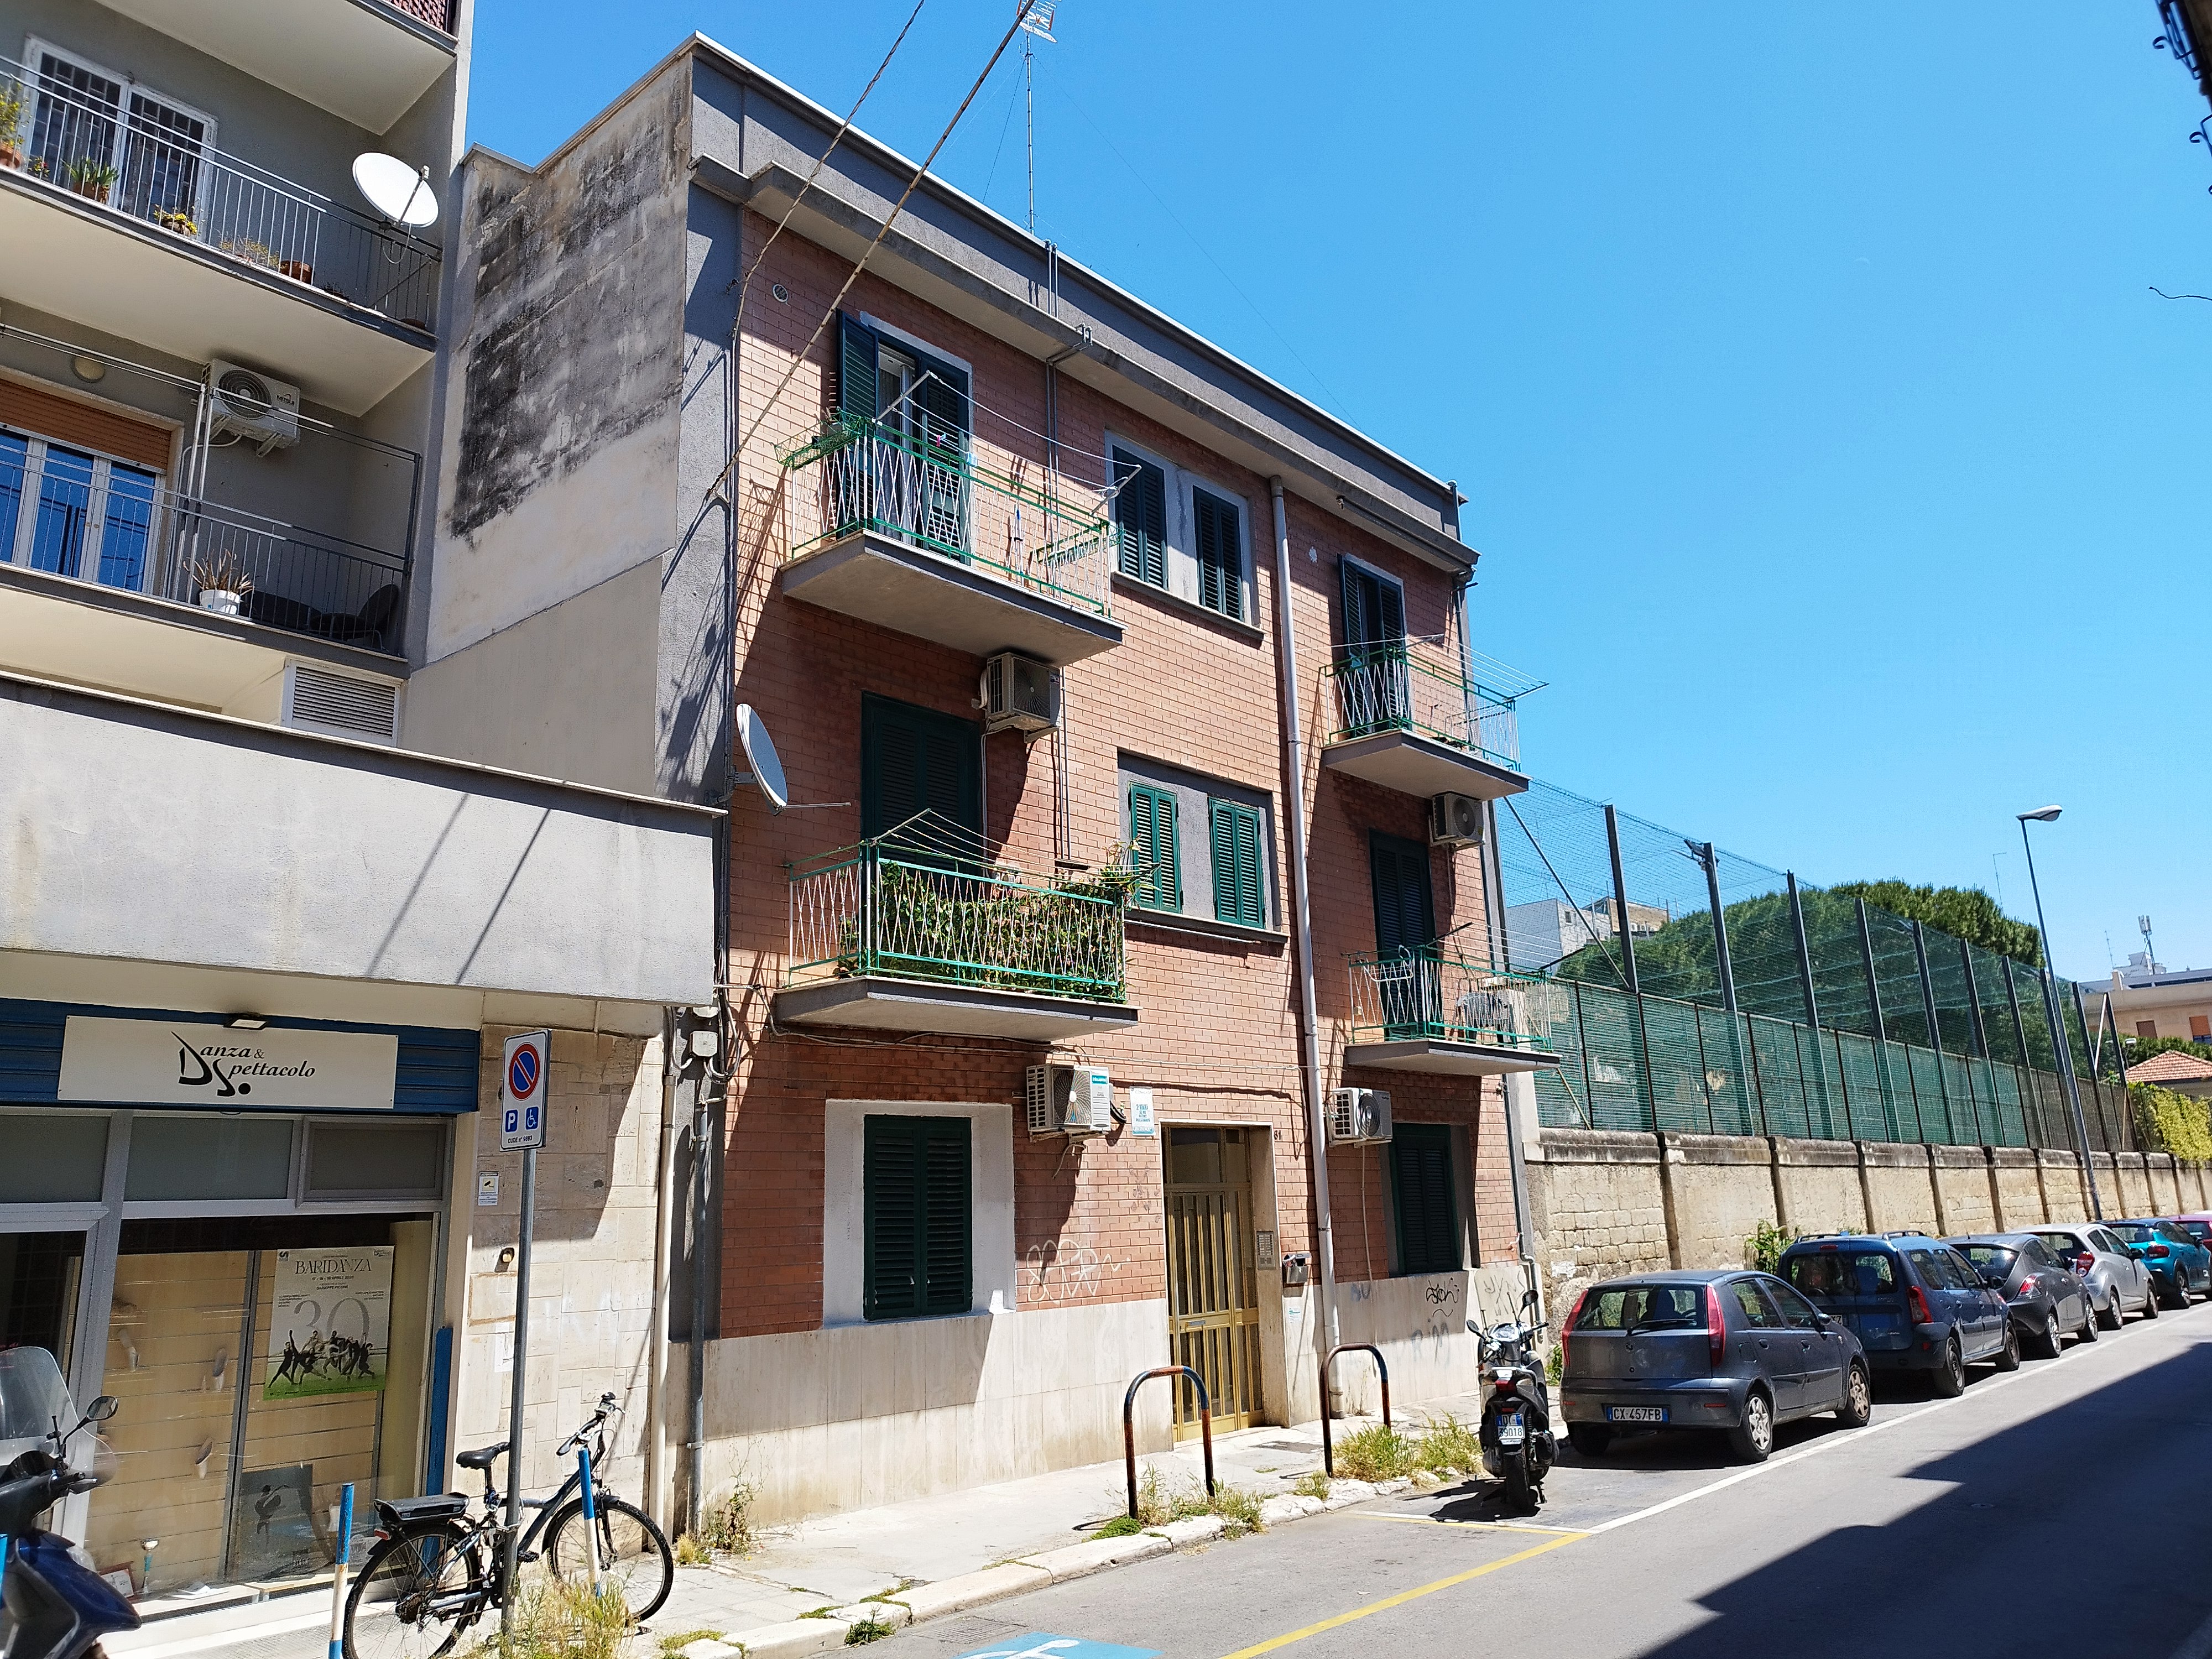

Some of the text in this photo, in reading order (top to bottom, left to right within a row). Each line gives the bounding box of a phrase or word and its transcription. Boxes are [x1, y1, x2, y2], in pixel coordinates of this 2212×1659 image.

[212, 1058, 315, 1097] Spettacolo
[295, 1258, 372, 1275] BARIDANZA
[1499, 1427, 1522, 1437] 39018
